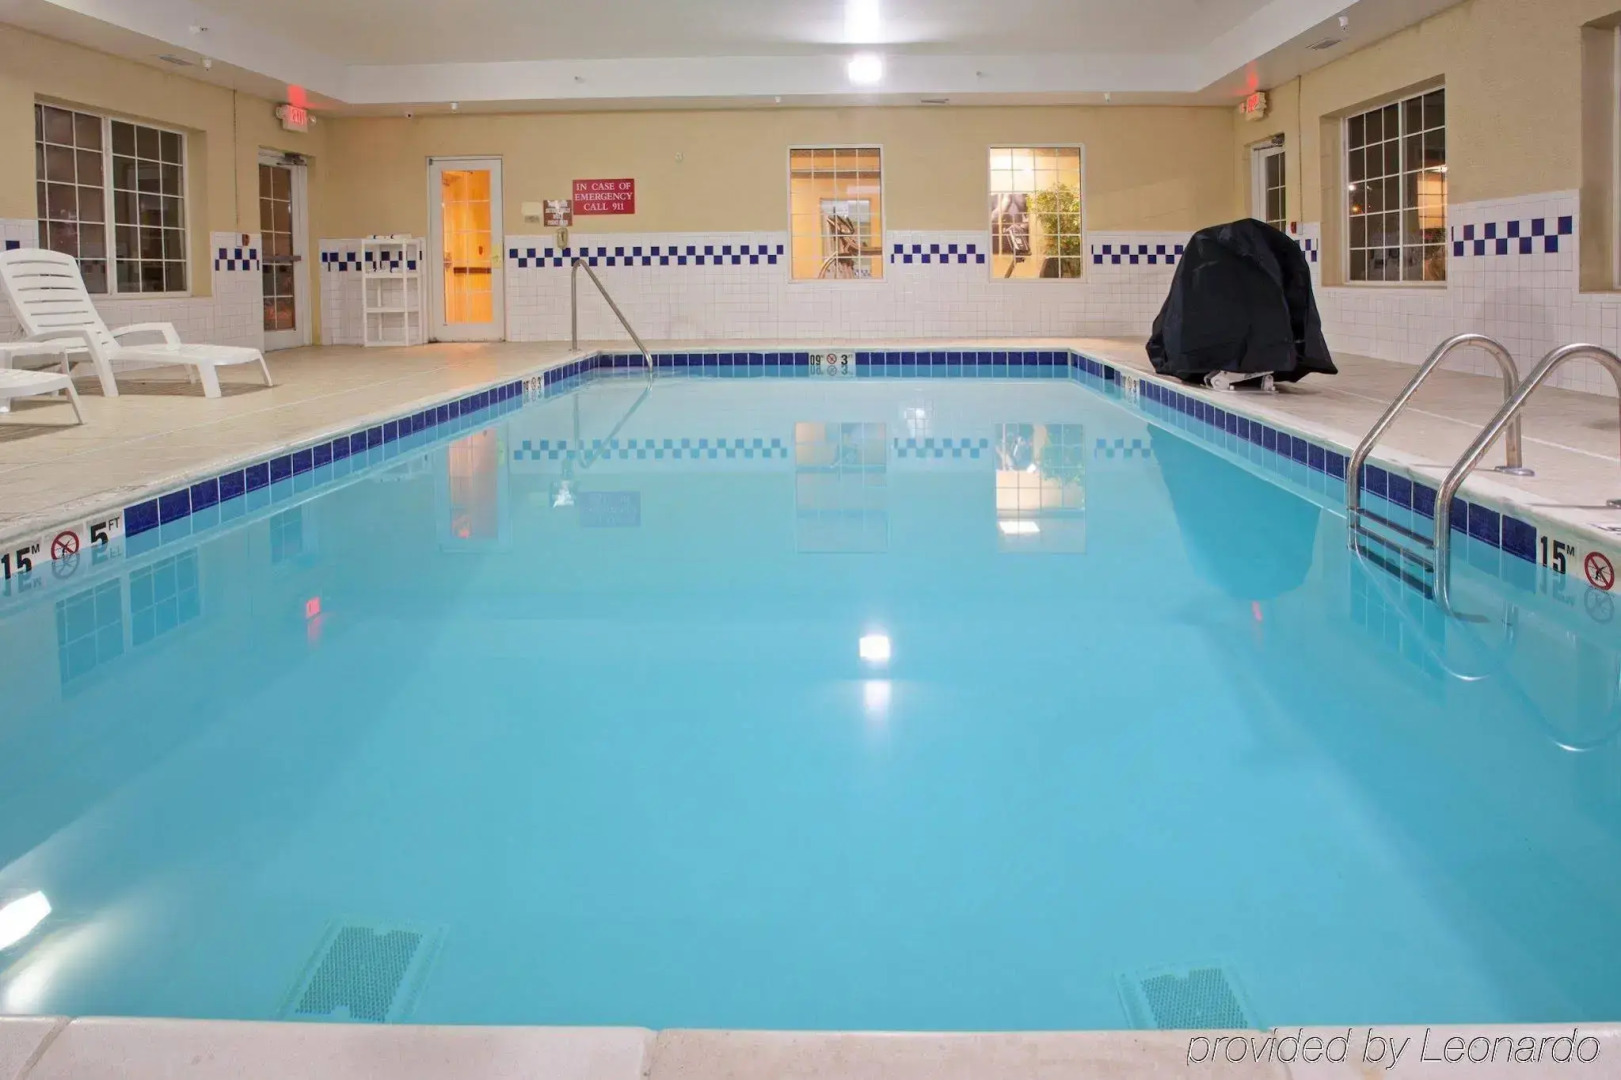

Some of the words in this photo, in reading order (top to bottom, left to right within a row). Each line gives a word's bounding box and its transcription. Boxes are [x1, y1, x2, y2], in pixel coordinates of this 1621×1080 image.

[576, 183, 587, 191] IN
[591, 182, 615, 191] CASE
[618, 182, 632, 191] OF
[574, 192, 633, 201] EMERGENCY
[583, 202, 608, 212] CALL
[612, 202, 625, 211] 911
